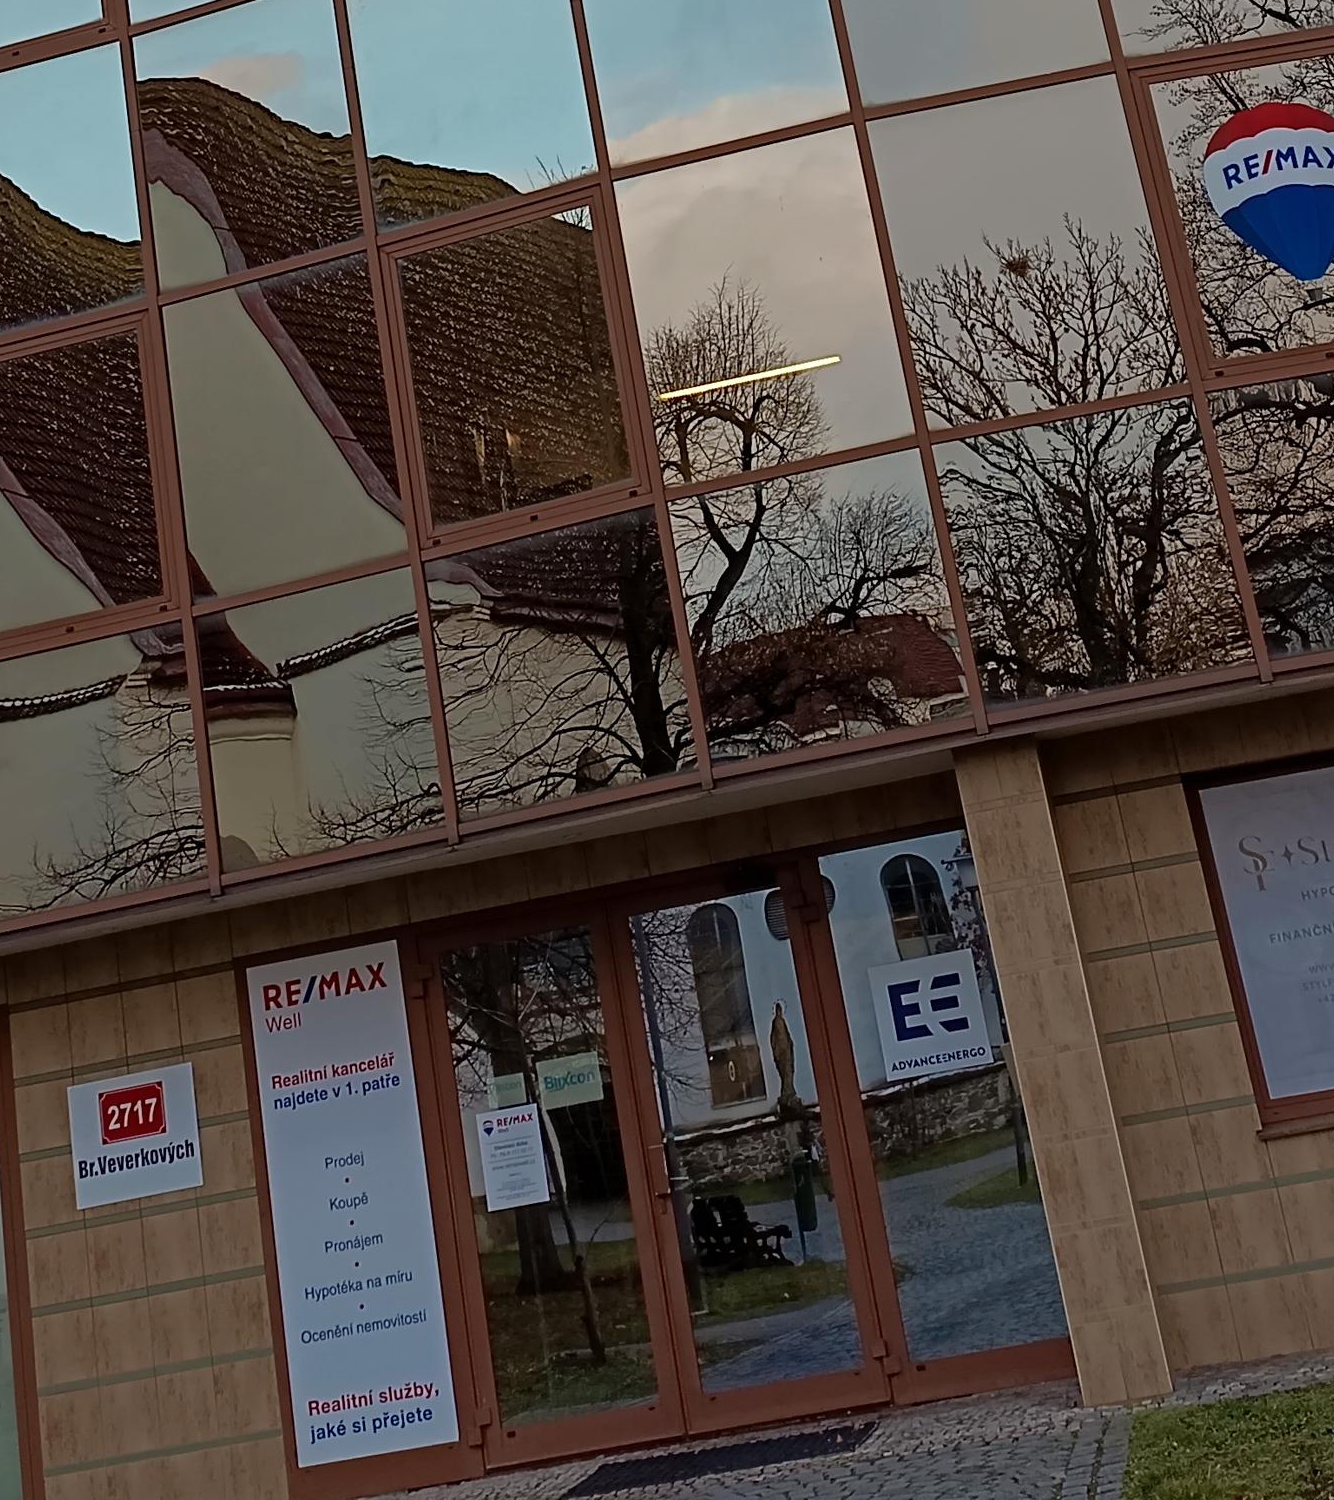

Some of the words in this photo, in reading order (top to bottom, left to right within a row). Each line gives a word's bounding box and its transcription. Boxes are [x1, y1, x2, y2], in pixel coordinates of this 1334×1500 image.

[262, 961, 388, 1011] RE/MAX
[265, 1011, 302, 1033] Well
[271, 1065, 328, 1089] Realitní
[331, 1051, 395, 1079] kancelář
[273, 1087, 328, 1110] najdete
[332, 1086, 341, 1098] v
[345, 1081, 359, 1096] 1.
[362, 1073, 401, 1097] patře
[107, 1097, 158, 1132] 2717
[496, 1112, 534, 1128] RE/MAX
[78, 1139, 195, 1179] Br.Veverkových
[324, 1150, 365, 1170] Prodej
[324, 1233, 384, 1253] Pronájem
[304, 1279, 363, 1302] Hypotéka
[366, 1277, 382, 1289] na
[385, 1270, 413, 1286] míru
[300, 1322, 354, 1345] Ocenění
[356, 1308, 427, 1335] nemovitostí
[308, 1389, 374, 1417] Realitní
[378, 1381, 440, 1405] služby,
[310, 1420, 347, 1445] jaké
[352, 1416, 367, 1434] si
[372, 1407, 434, 1434] přejete
